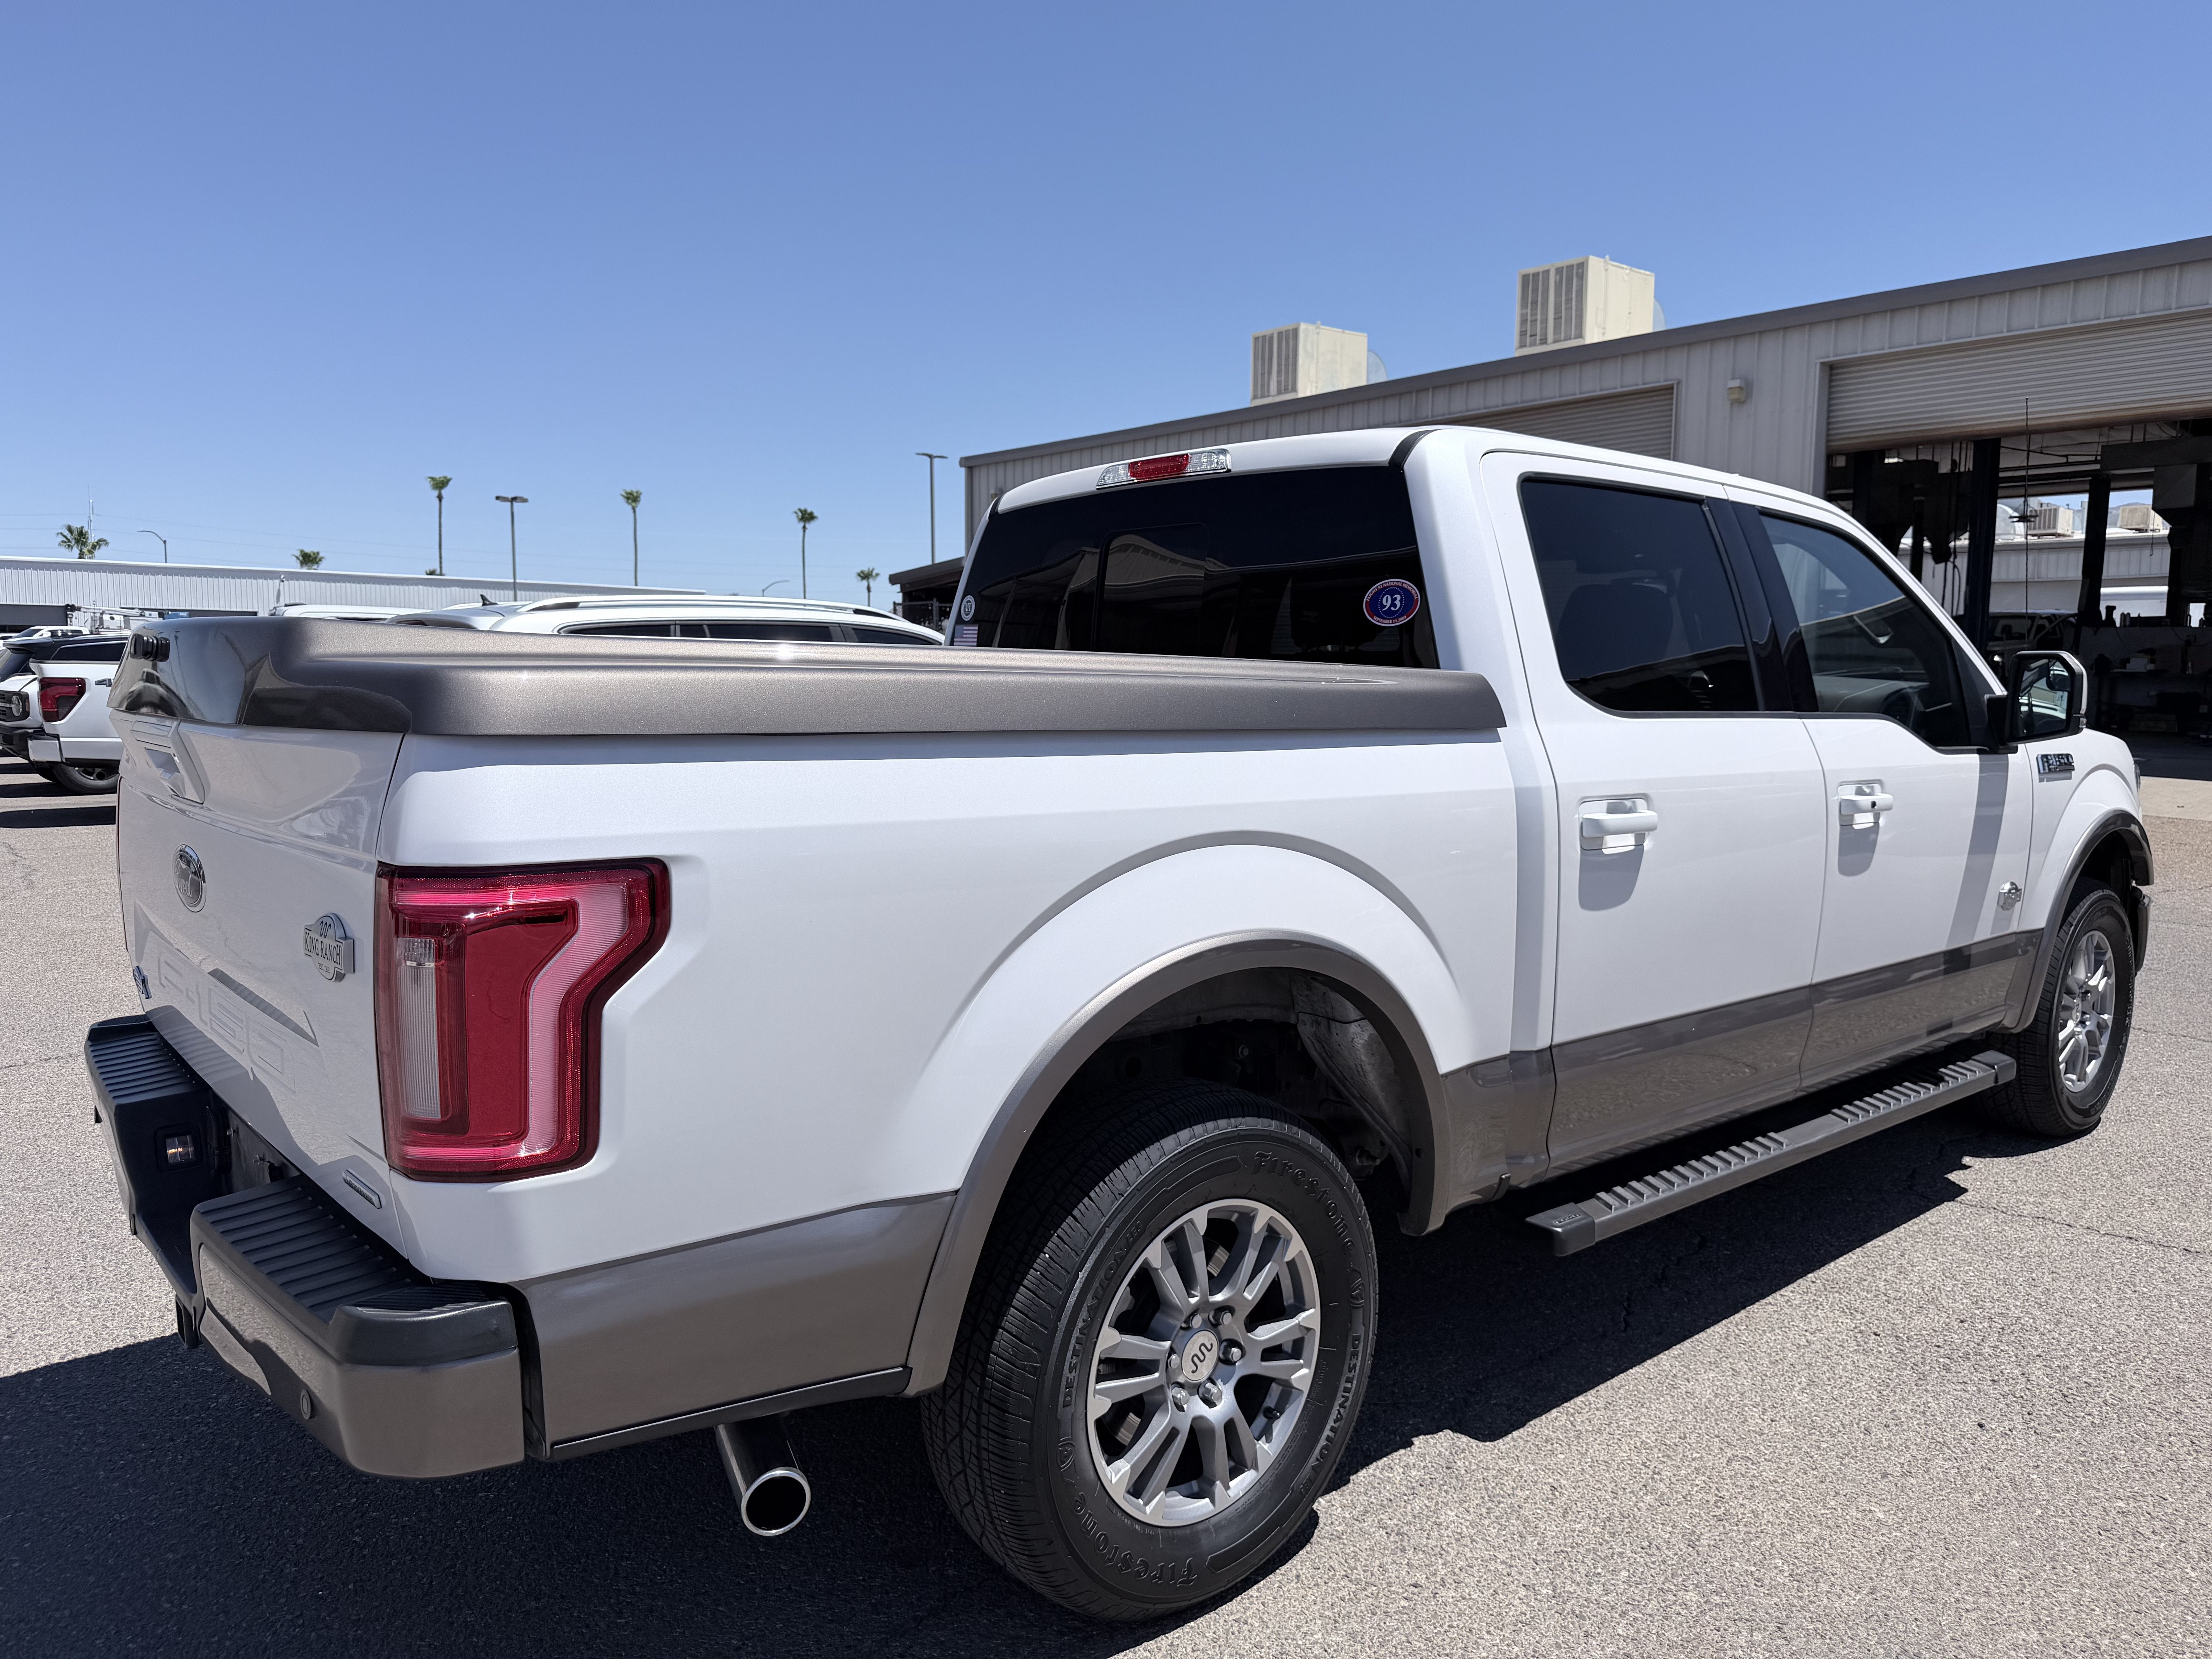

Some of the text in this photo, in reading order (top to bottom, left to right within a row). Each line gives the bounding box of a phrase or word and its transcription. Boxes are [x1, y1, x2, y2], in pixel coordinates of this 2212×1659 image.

[1366, 587, 1377, 601] FLIGHT
[1403, 583, 1418, 599] MEMORIAL
[1381, 594, 1401, 611] 93
[1373, 615, 1392, 623] SEPTEMBER
[175, 858, 192, 898] Ford
[305, 931, 341, 965] KING RANCH
[1250, 1151, 1356, 1257] Firestone
[1062, 1247, 1128, 1408] DESTINATION
[1311, 1333, 1362, 1472] DESTINATION
[1073, 1492, 1197, 1587] Firestone
